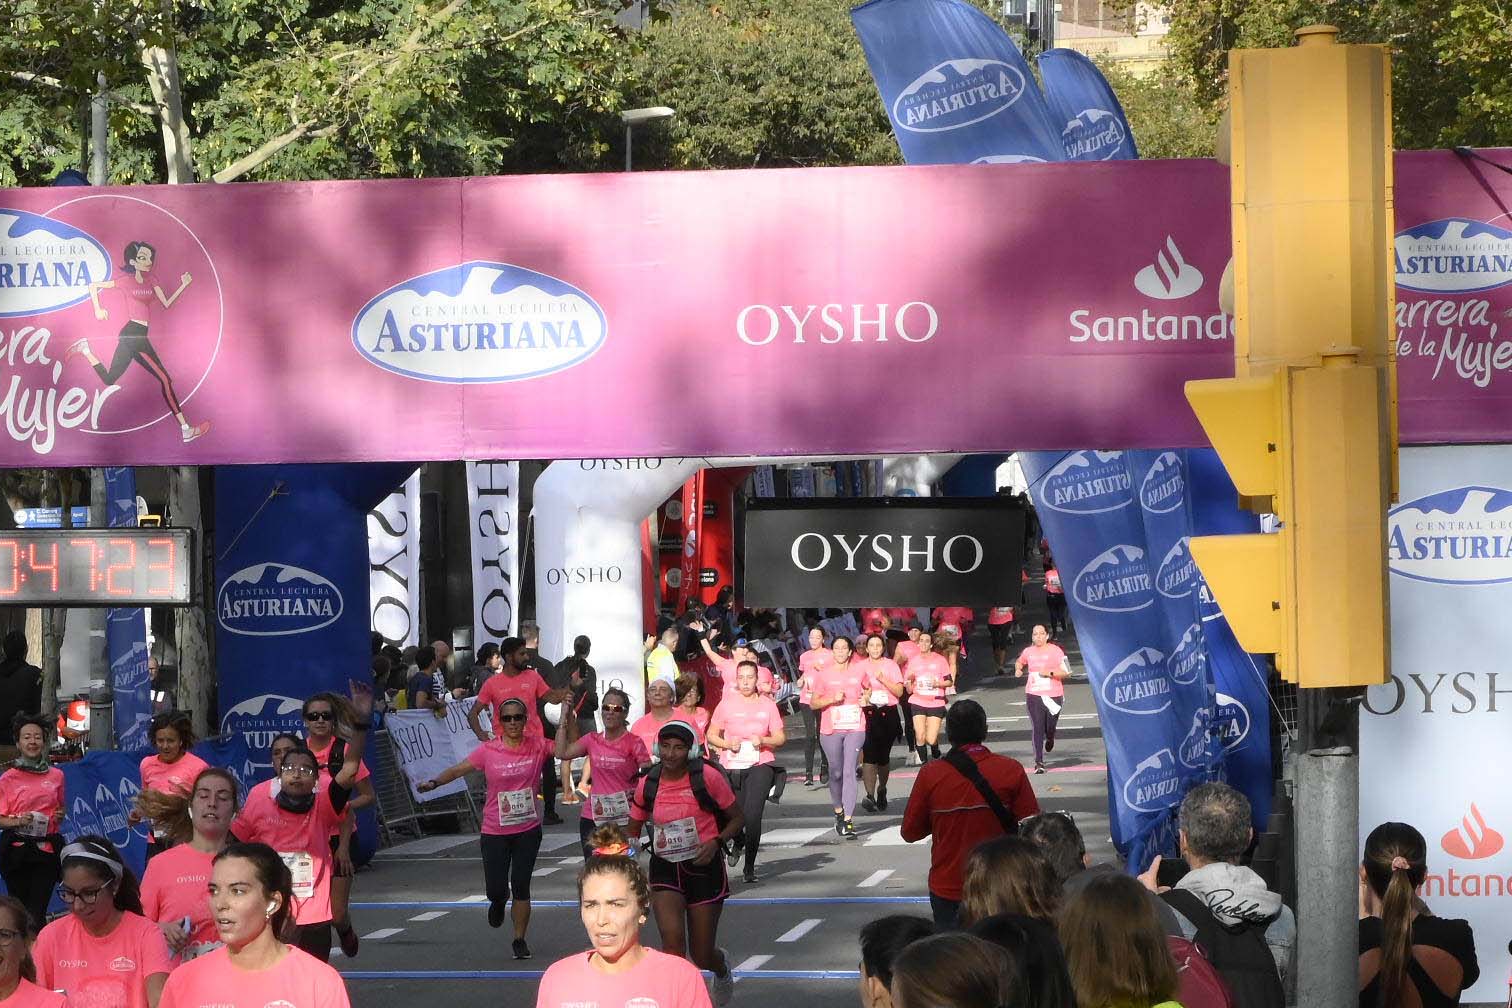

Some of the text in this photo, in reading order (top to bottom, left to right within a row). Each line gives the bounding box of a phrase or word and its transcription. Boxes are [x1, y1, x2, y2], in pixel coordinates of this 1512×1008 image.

[14, 244, 87, 257] LECHERA
[1409, 242, 1512, 253] CENTRAL LECHER
[411, 301, 579, 317] CENTRAL LECHERA
[1395, 299, 1490, 327] arrera
[371, 308, 587, 353] ASTURIANA
[736, 301, 939, 346] OYSHO
[1069, 308, 1236, 343] Santand
[1418, 330, 1437, 356] la
[1432, 323, 1512, 388] Muje
[1416, 521, 1482, 530] CENTRAL
[790, 531, 984, 574] OYSHO
[546, 565, 622, 585] OYSHO
[234, 587, 330, 597] CENTRAL LECHERA
[221, 593, 335, 620] ASTURIANA
